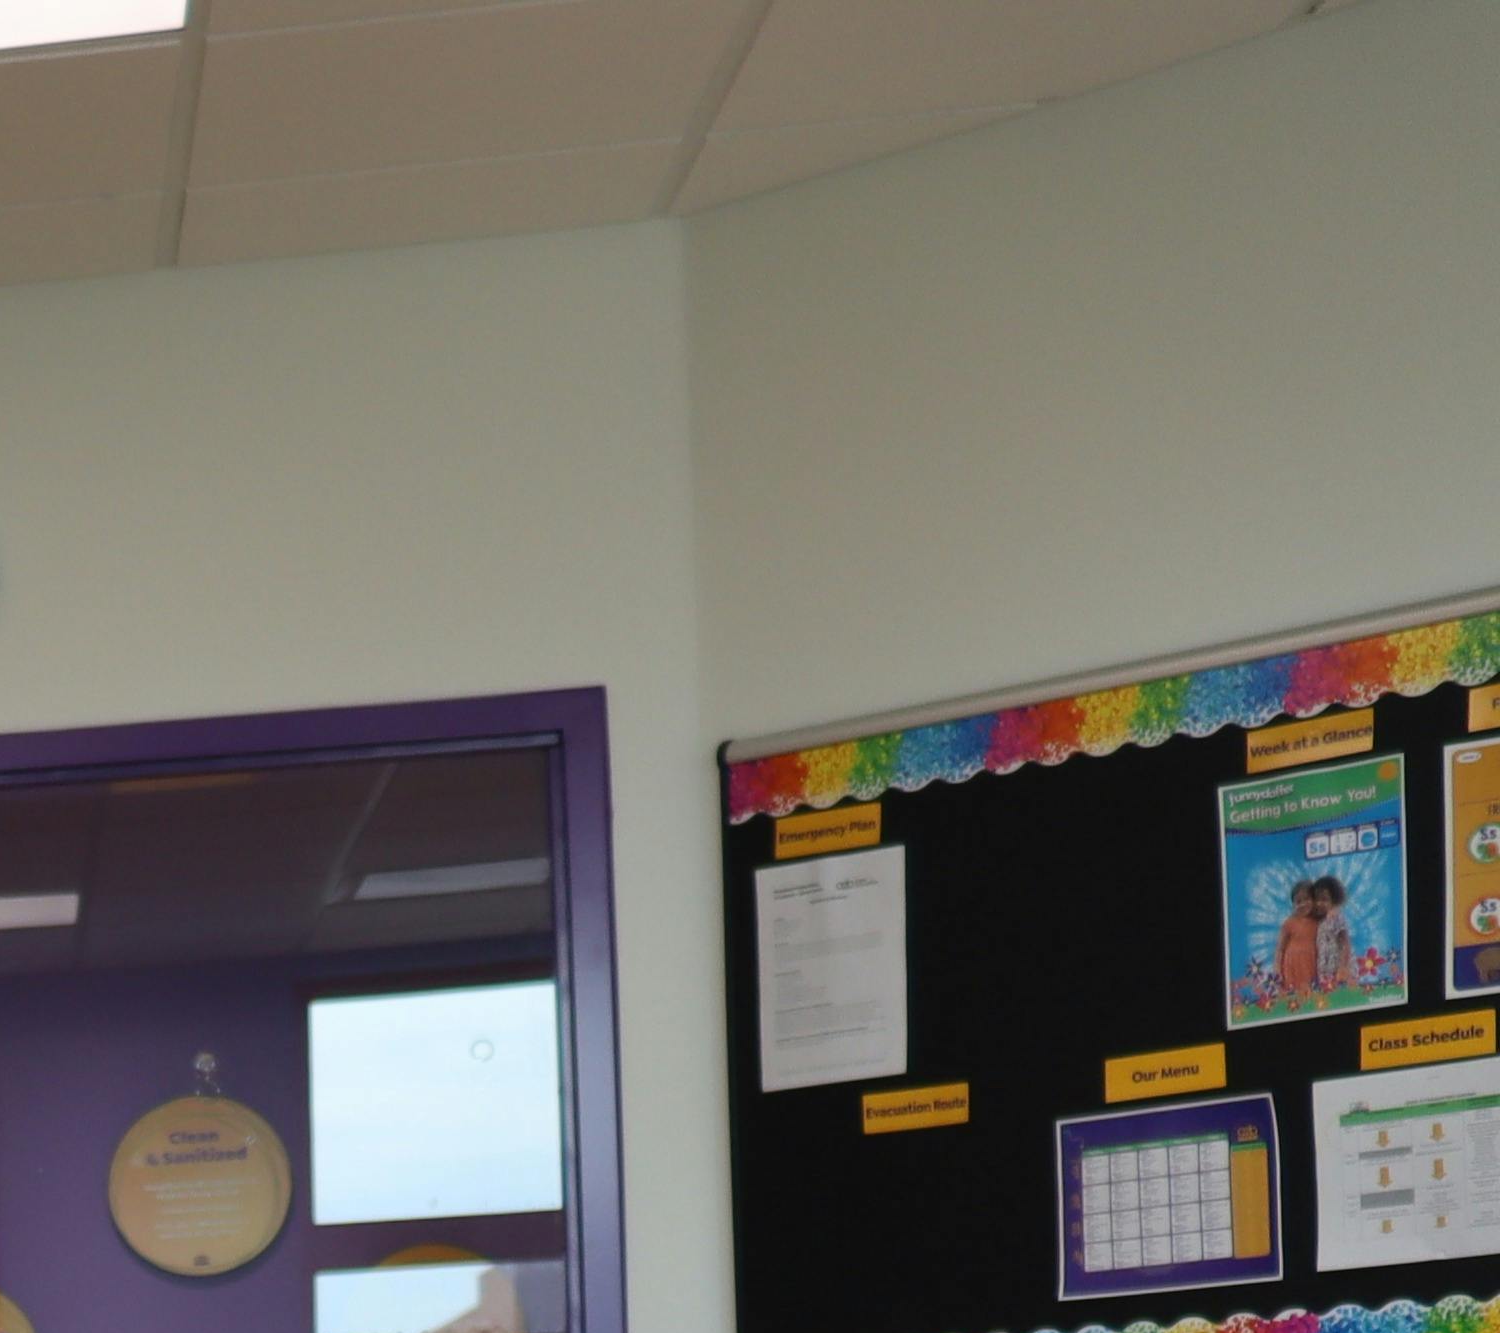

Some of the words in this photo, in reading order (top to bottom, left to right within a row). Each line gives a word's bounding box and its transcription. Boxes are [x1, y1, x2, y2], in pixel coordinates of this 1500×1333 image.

[1250, 741, 1290, 758] Week
[1293, 737, 1308, 749] at
[1310, 737, 1319, 745] a
[1323, 726, 1372, 744] Glance
[1229, 805, 1281, 824] Getting
[1284, 800, 1298, 813] to
[1301, 794, 1342, 809] Know
[1348, 785, 1376, 801] You!
[779, 825, 846, 844] Emergency
[850, 818, 876, 832] Plan
[1368, 1038, 1408, 1052] Class
[1412, 1026, 1485, 1047] Schedule
[1132, 1070, 1158, 1083] Our
[1161, 1064, 1200, 1080] Menu
[866, 1101, 931, 1118] Evacuation
[933, 1098, 967, 1113] Route
[169, 1131, 220, 1144] Clean
[163, 1146, 248, 1165] Sanitized
